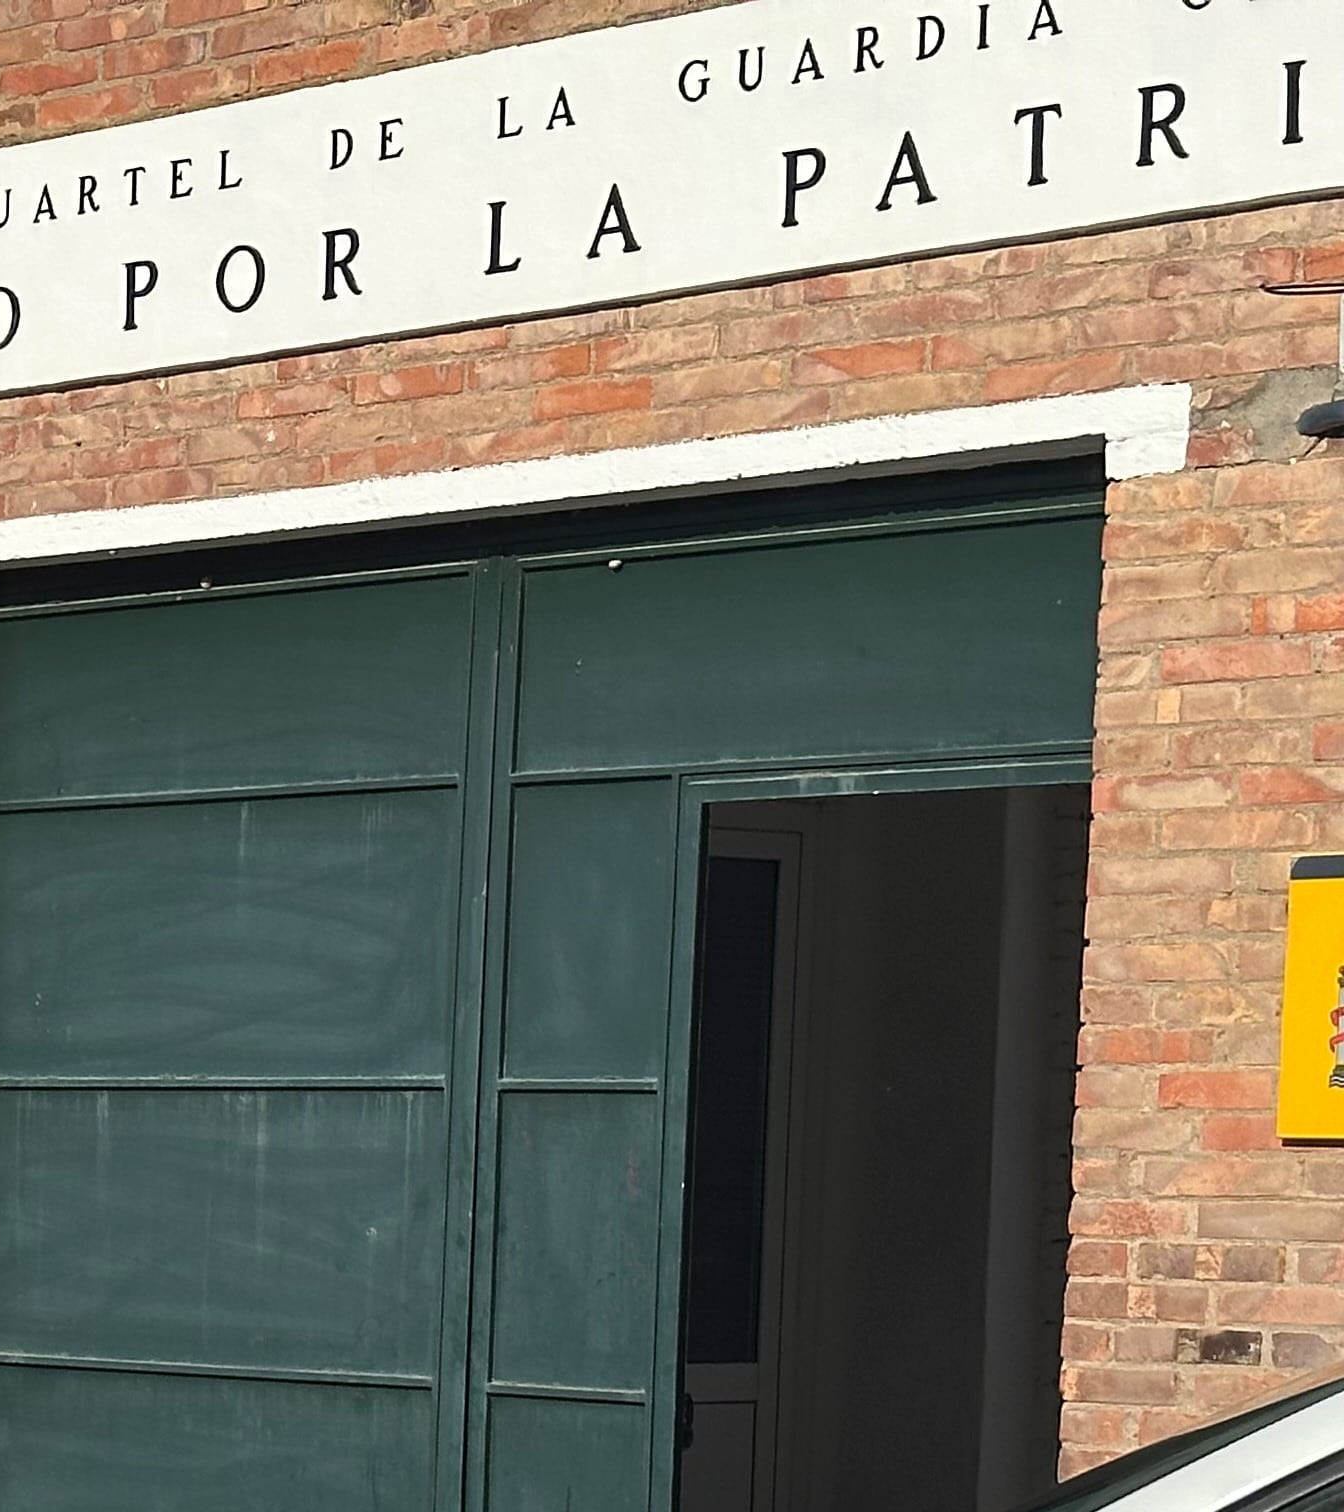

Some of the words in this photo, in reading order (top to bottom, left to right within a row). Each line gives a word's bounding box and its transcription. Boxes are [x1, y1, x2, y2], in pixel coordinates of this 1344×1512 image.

[328, 118, 405, 170] DE
[497, 86, 576, 140] LA
[678, 0, 1063, 103] GUARDIA
[122, 228, 364, 332] POR
[483, 183, 643, 276] LA
